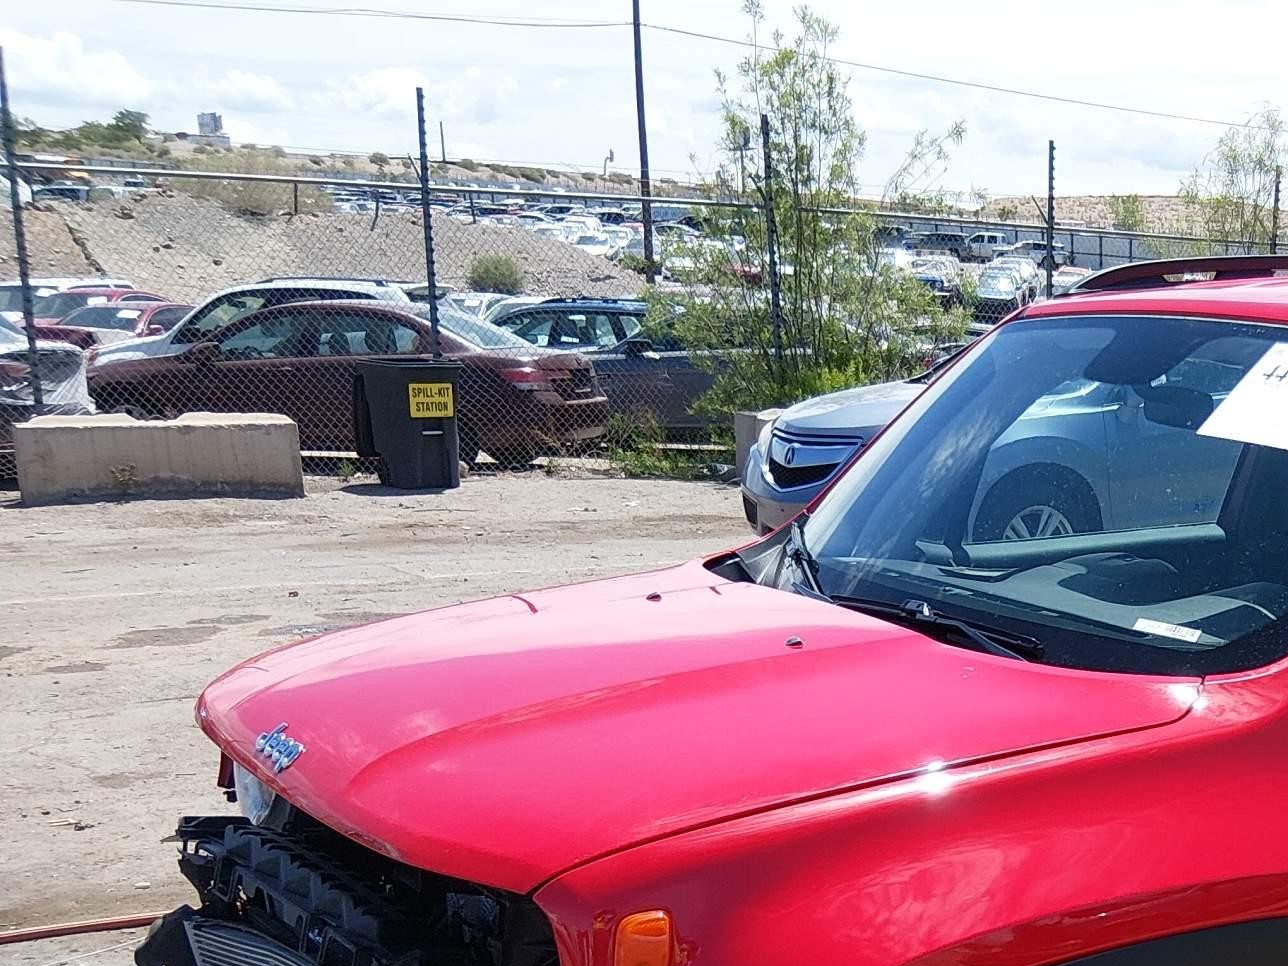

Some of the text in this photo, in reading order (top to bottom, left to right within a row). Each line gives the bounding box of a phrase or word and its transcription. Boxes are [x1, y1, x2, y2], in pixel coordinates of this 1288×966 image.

[411, 387, 451, 398] SPILL-KIT
[415, 401, 449, 413] STATION
[256, 722, 305, 774] Jeep
